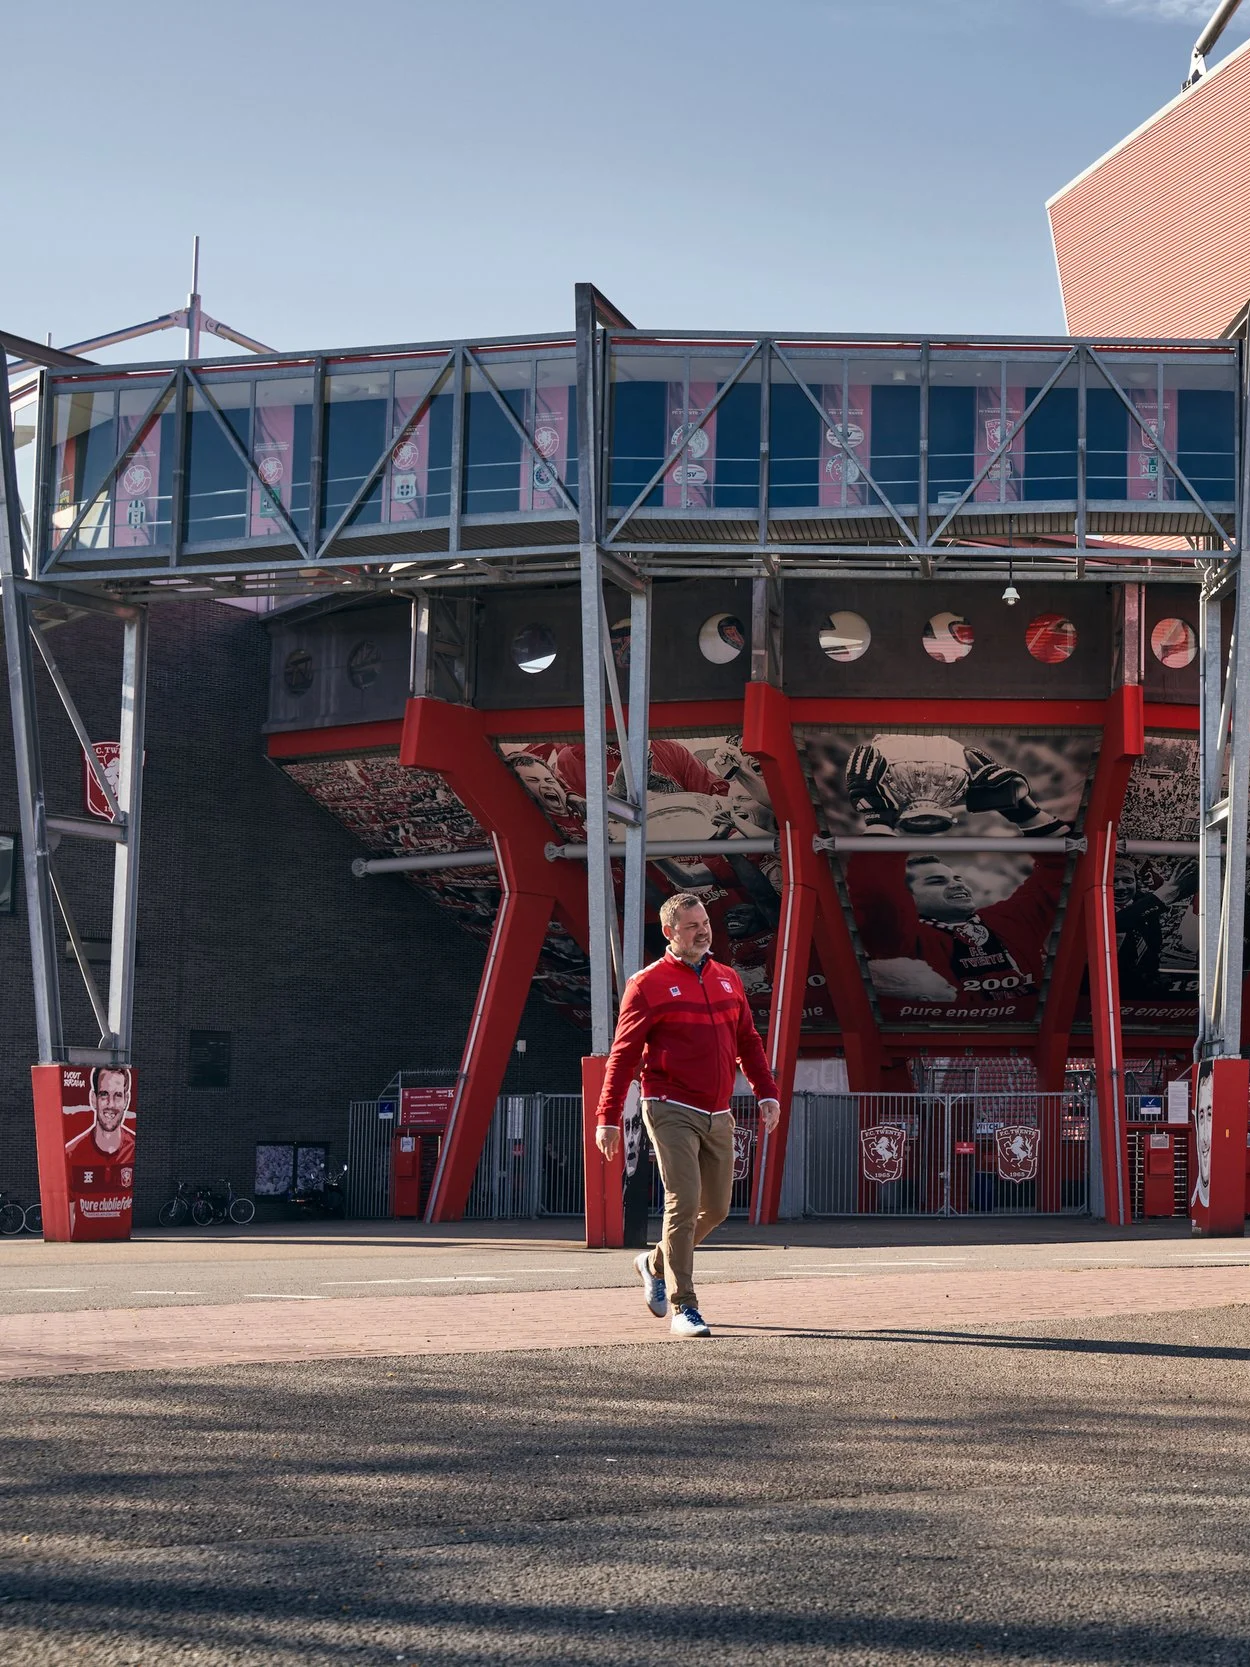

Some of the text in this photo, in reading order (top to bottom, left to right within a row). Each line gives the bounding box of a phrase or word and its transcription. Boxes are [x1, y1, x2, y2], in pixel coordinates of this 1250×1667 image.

[959, 953, 1005, 969] TWENTE
[963, 973, 1036, 991] 2001
[900, 1004, 1016, 1018] pure energie
[447, 1089, 454, 1098] K
